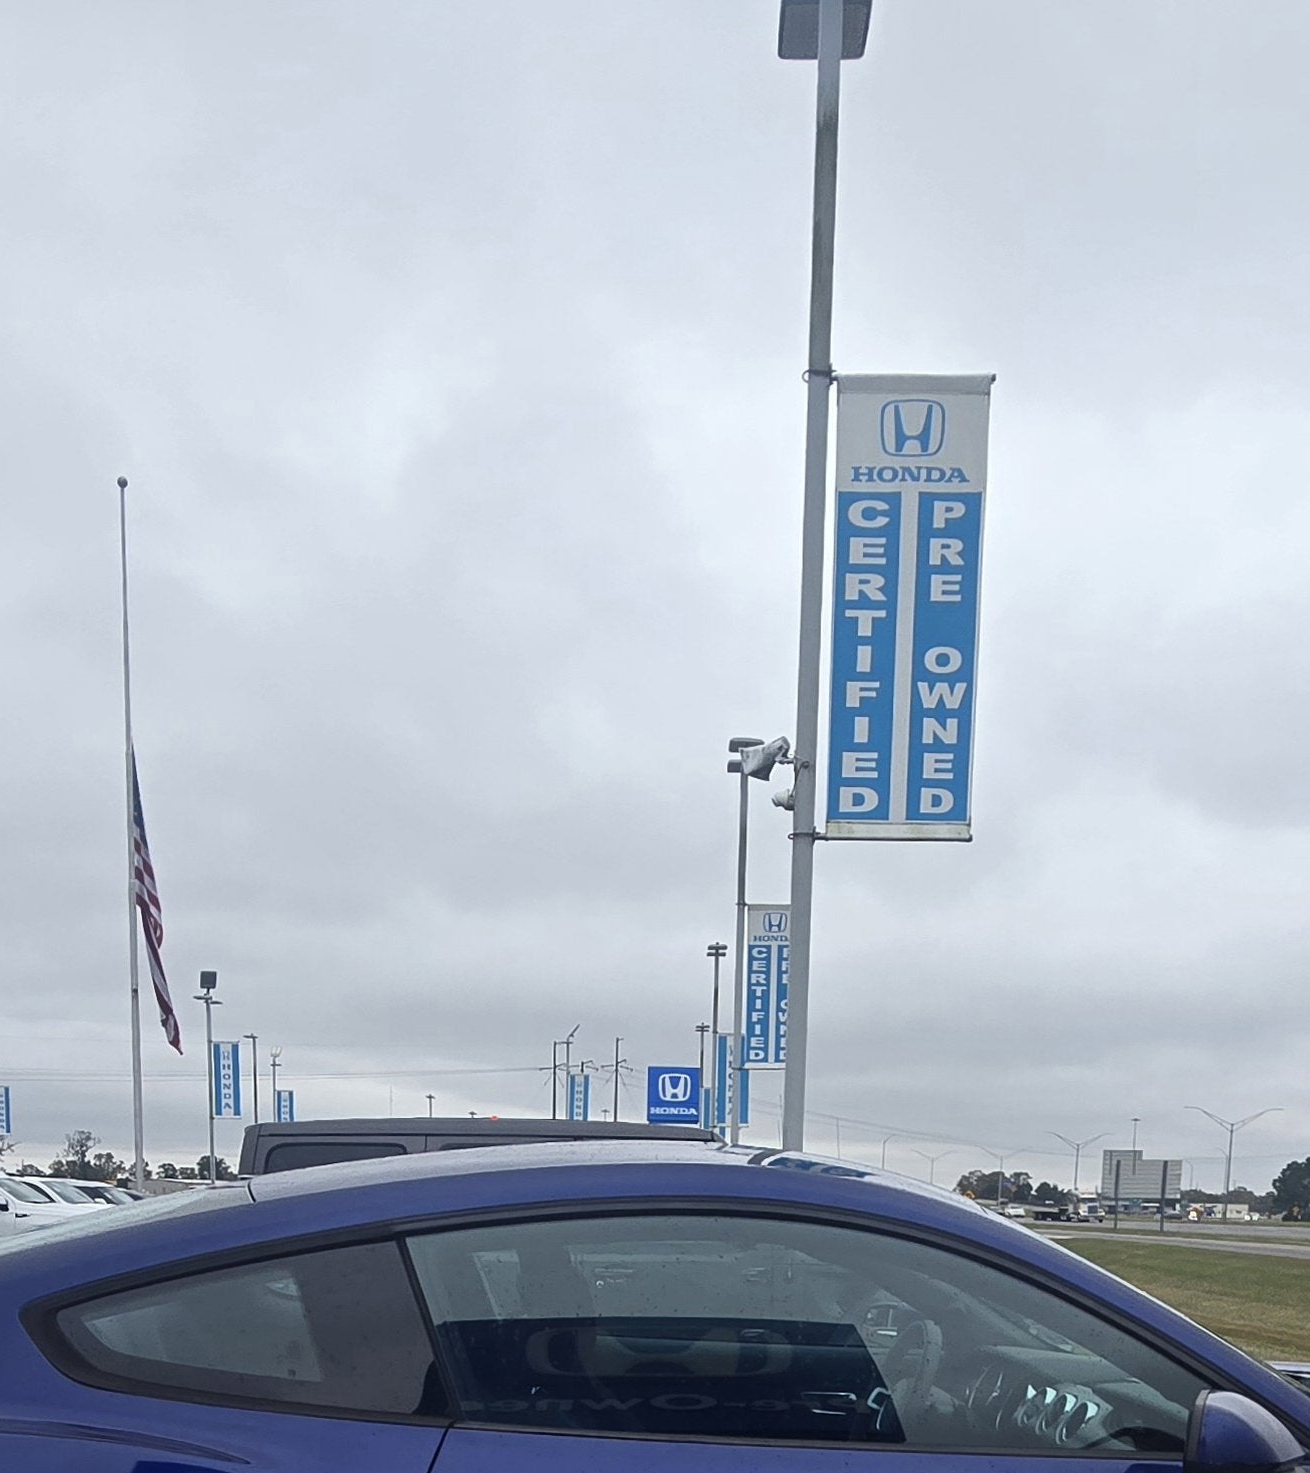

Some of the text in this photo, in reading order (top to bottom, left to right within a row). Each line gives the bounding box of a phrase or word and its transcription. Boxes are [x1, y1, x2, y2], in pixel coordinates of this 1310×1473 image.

[851, 465, 970, 483] HONDA
[838, 499, 891, 813] CERTIFIED
[917, 500, 968, 814] PRE OWNED
[753, 934, 789, 943] HOND
[749, 947, 768, 1061] CERTIFIED
[221, 1063, 232, 1110] HONDA
[575, 1089, 583, 1117] HOND
[650, 1106, 698, 1115] HONDA
